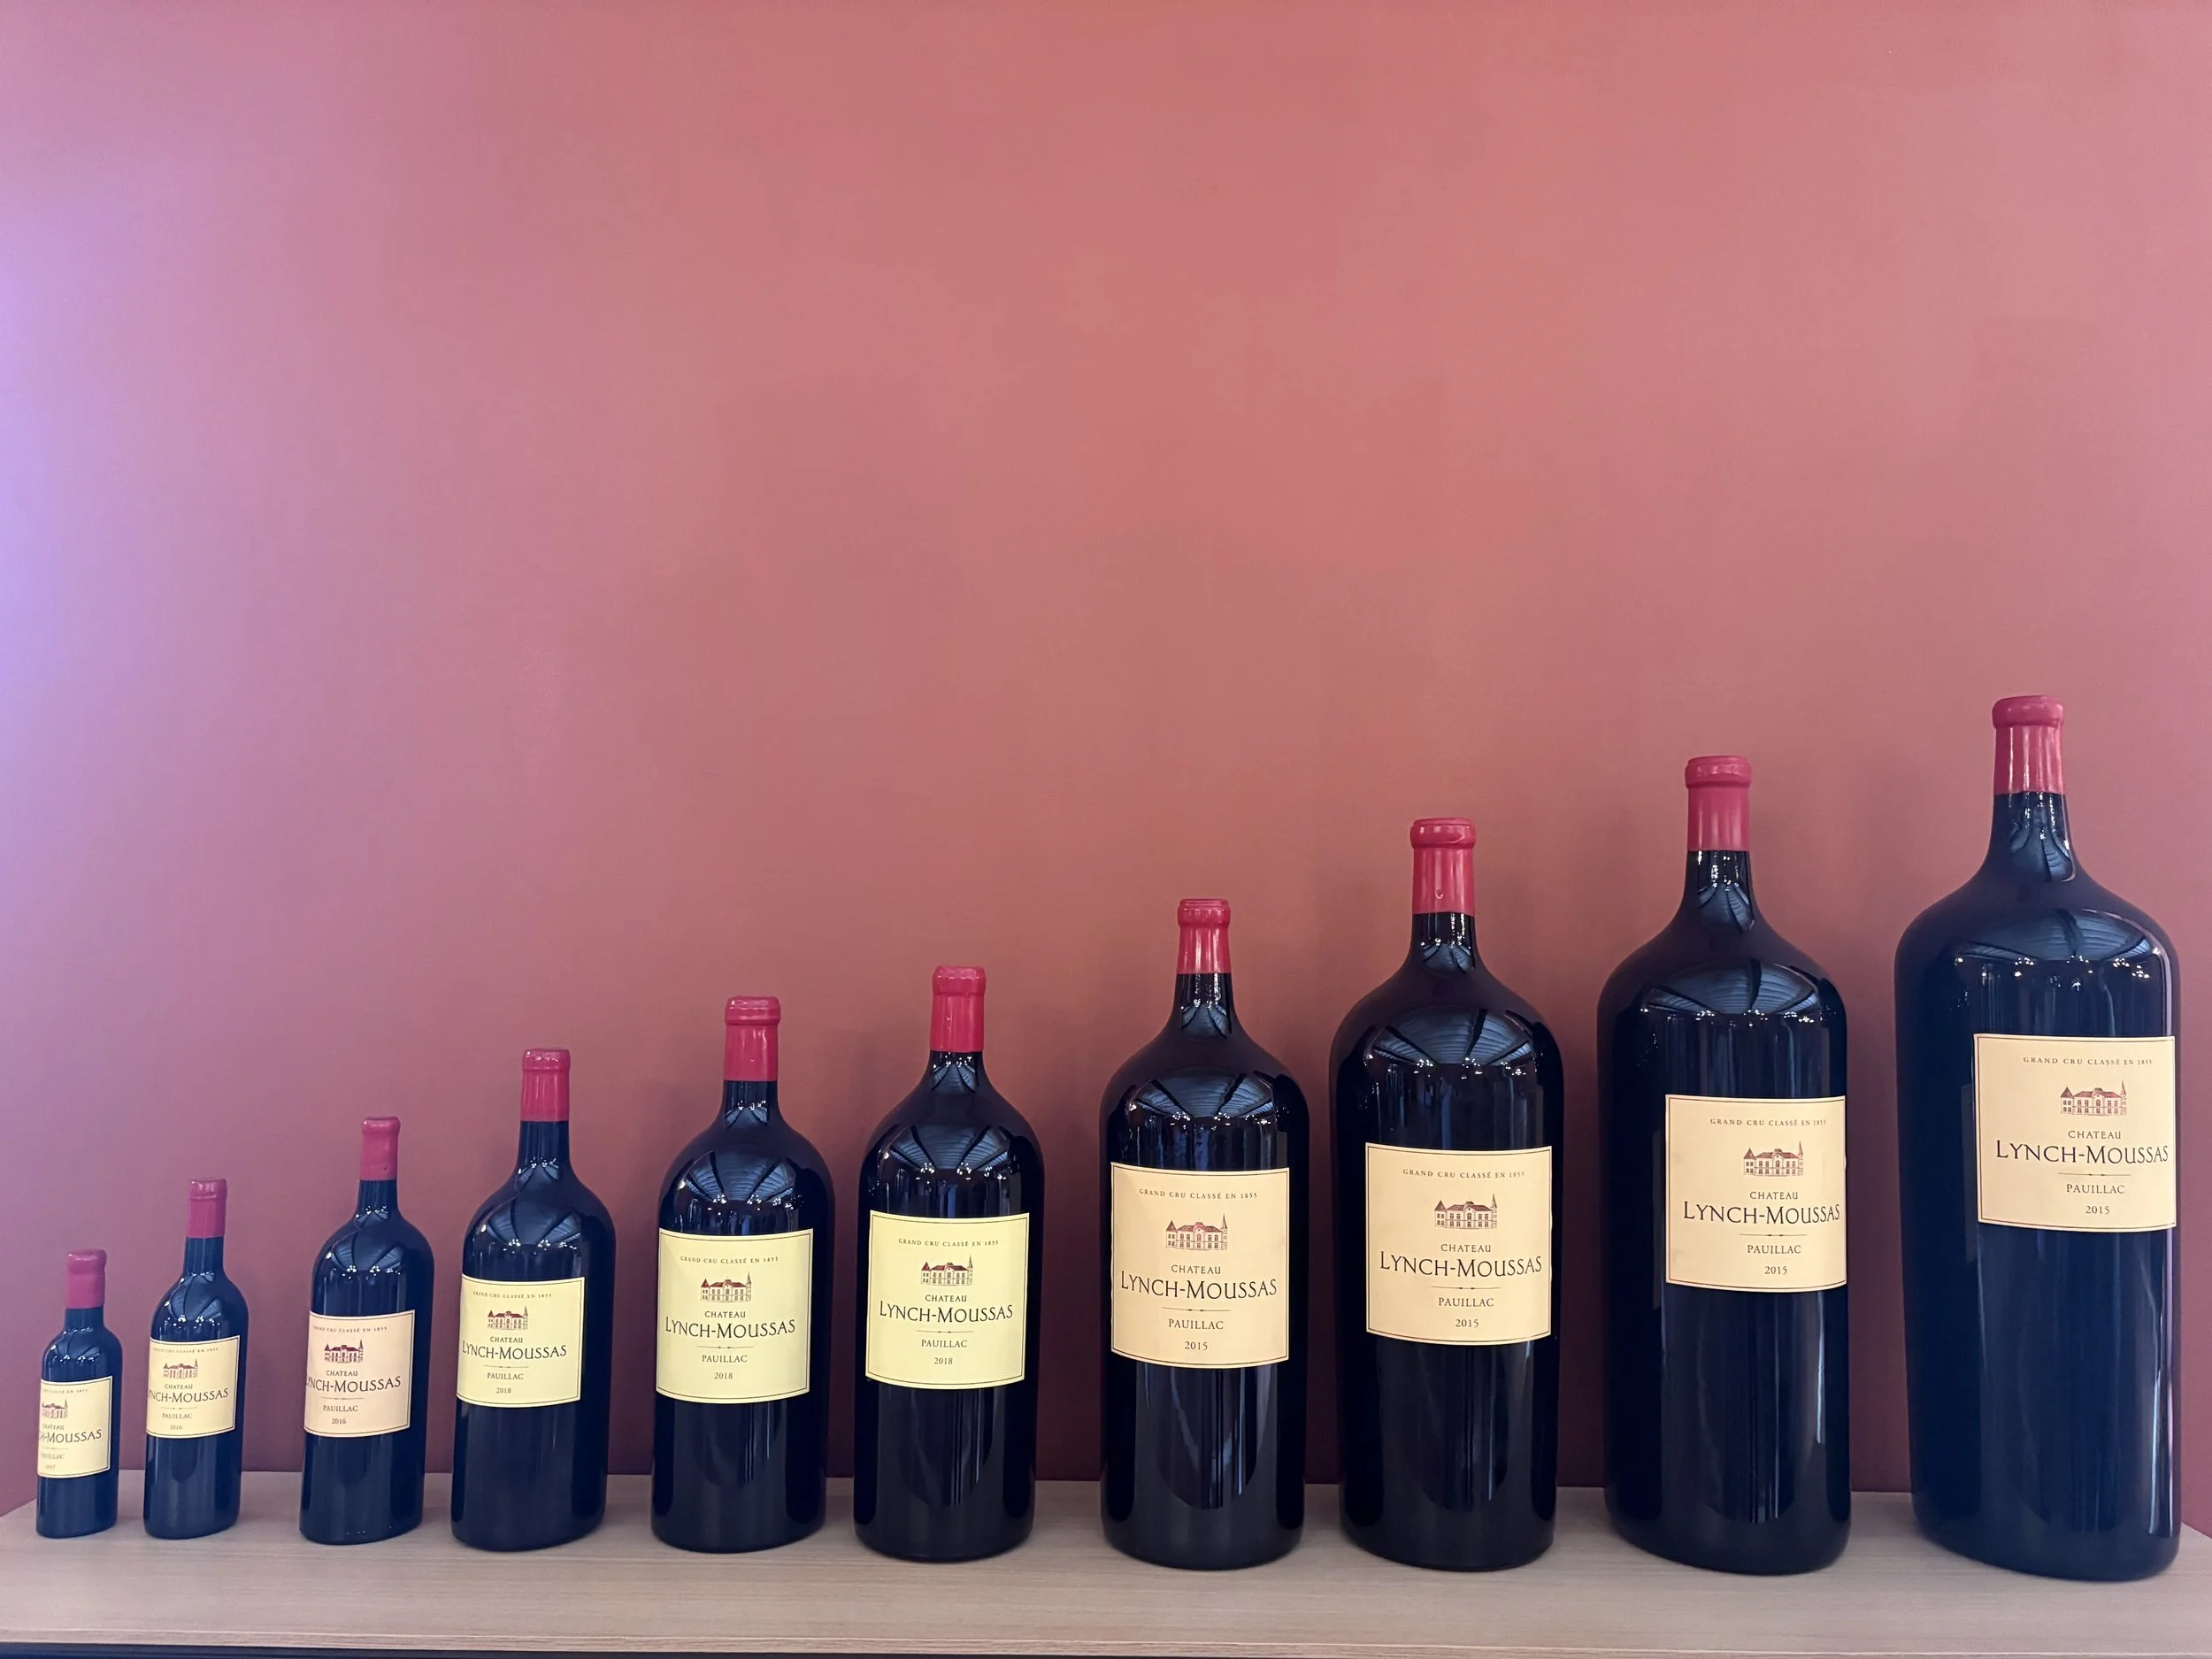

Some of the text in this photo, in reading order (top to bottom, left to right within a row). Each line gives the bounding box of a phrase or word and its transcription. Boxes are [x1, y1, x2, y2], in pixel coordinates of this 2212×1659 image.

[2068, 1131, 2122, 1140] CHATEAU
[1996, 1140, 2169, 1164] LYNCH-MOUSSAS
[1139, 1188, 1165, 1197] GRAND
[2067, 1184, 2125, 1194] PAUILLAC
[1684, 1201, 1839, 1224] LYNCH-MOUSSAS
[2085, 1205, 2110, 1214] 2015
[1440, 1243, 1491, 1253] CHATEAU
[1747, 1245, 1801, 1254] PAUILLAC
[1171, 1264, 1221, 1274] CHATEAU
[1380, 1251, 1542, 1278] LYNCH-MOUSSAS
[1121, 1271, 1277, 1299] LYNCH-MOUSSAS
[1439, 1297, 1494, 1307] PAUILLAC
[879, 1301, 1013, 1323] LYNCH-MOUSSAS
[665, 1317, 795, 1339] LYNCH-MOUSSAS
[1168, 1318, 1224, 1330] PAUILLAC
[462, 1340, 567, 1359] LYNCH-MOUSSAS
[1185, 1341, 1208, 1350] 2015
[149, 1387, 228, 1402] NCH-MOUSSAS
